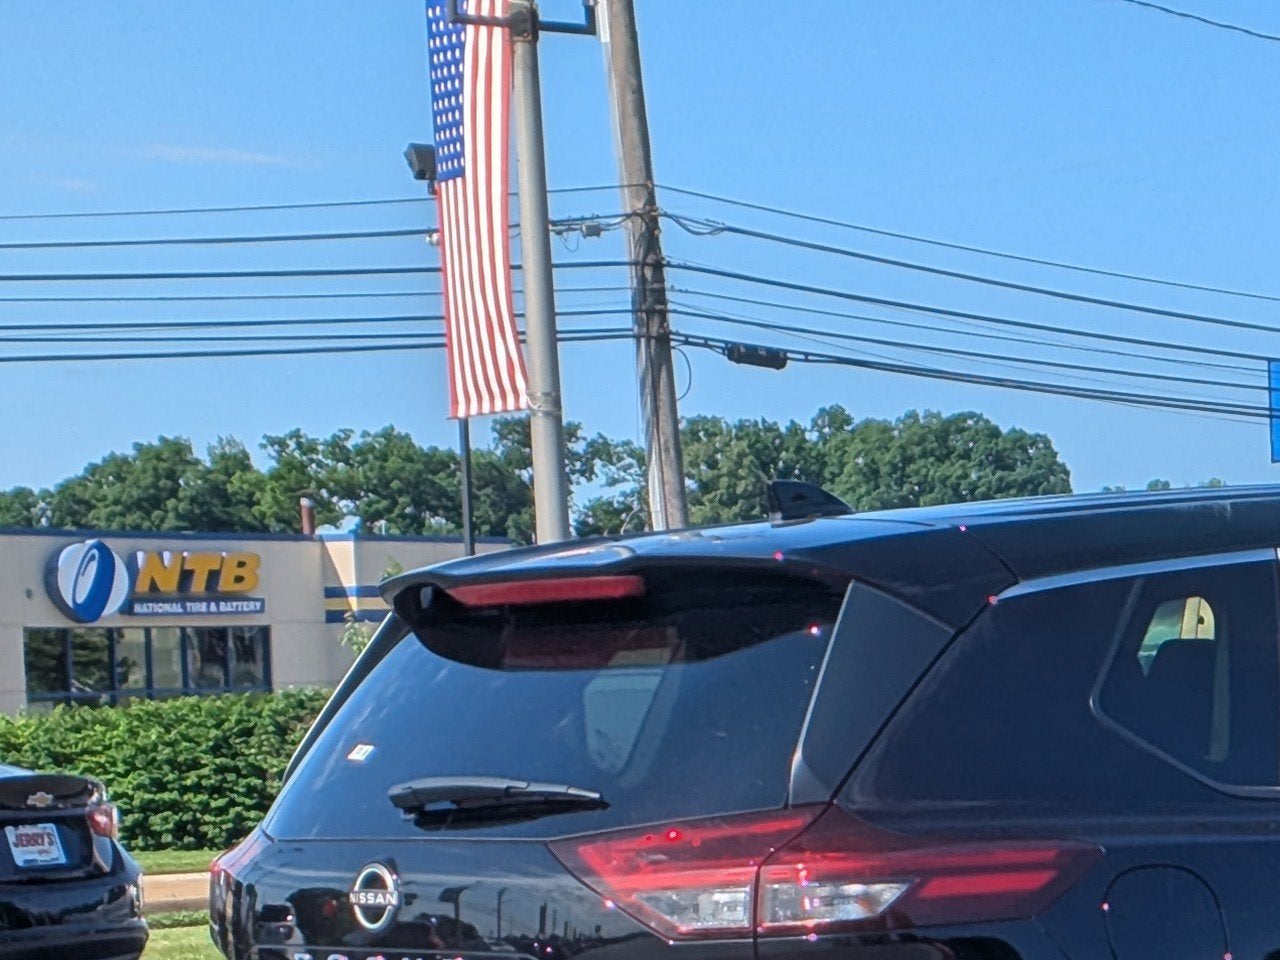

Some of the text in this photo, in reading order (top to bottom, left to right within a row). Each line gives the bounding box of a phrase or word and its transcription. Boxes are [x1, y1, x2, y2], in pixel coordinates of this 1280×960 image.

[135, 551, 261, 592] NTB
[133, 601, 262, 613] NATIONAL TIRE & BATTERY
[350, 892, 398, 904] NISSAN
